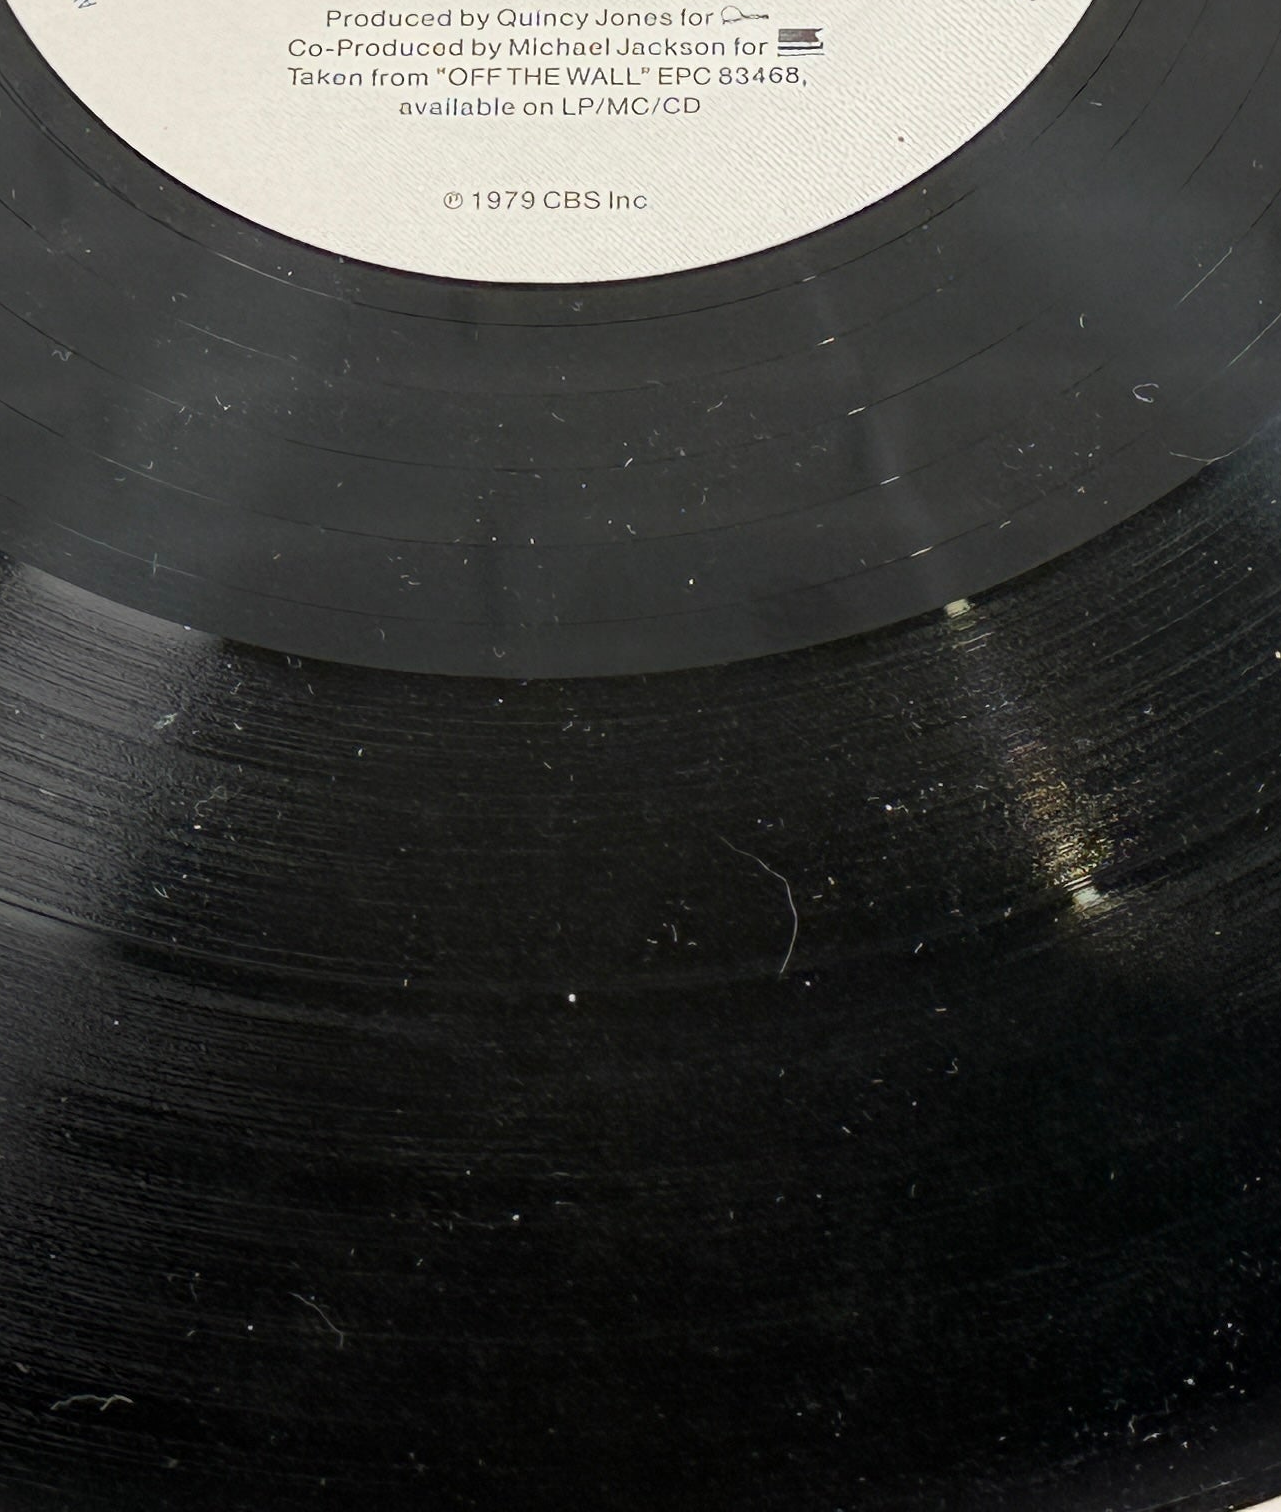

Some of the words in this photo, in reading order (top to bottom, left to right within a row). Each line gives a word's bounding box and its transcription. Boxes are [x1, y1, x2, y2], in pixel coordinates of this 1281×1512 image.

[326, 10, 452, 27] Produced
[460, 9, 490, 30] by
[497, 8, 589, 30] Quincy
[595, 9, 673, 27] Jones
[681, 8, 714, 26] for
[288, 39, 463, 57] Co-Produced
[471, 38, 502, 59] by
[509, 38, 610, 56] Michael
[616, 38, 725, 56] Jackson
[734, 37, 768, 56] for
[287, 67, 362, 86] Taken
[372, 68, 428, 86] from
[507, 67, 560, 86] THE
[659, 67, 711, 85] EPC
[719, 67, 807, 87] 83468,
[399, 98, 515, 116] available
[523, 101, 553, 116] on
[563, 97, 701, 116] LP/MC/CD
[473, 191, 535, 210] 1979
[544, 191, 601, 209] CBS
[610, 191, 648, 209] Inc
